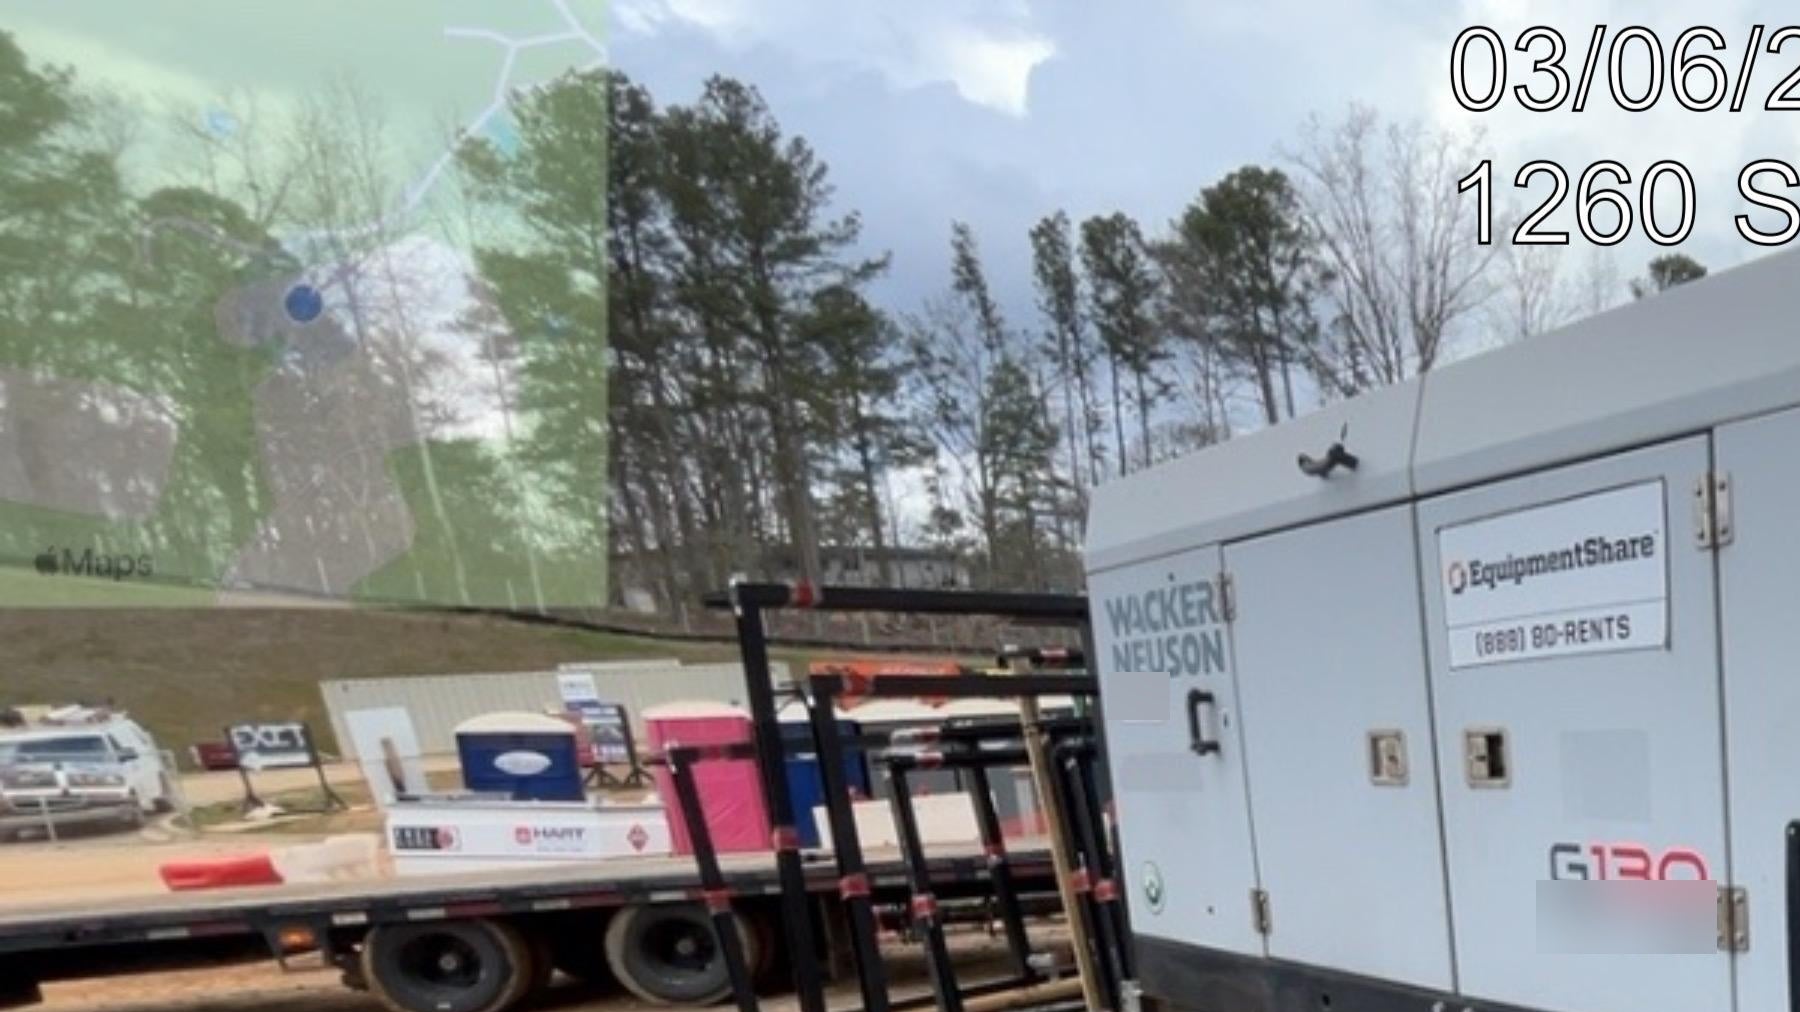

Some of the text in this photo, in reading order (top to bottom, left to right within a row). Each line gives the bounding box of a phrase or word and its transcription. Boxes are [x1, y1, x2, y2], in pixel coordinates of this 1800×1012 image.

[1469, 533, 1655, 589] EquipmentShare
[1105, 581, 1220, 638] WACKER
[1111, 628, 1226, 679] NEUSON
[230, 723, 305, 749] EXIT
